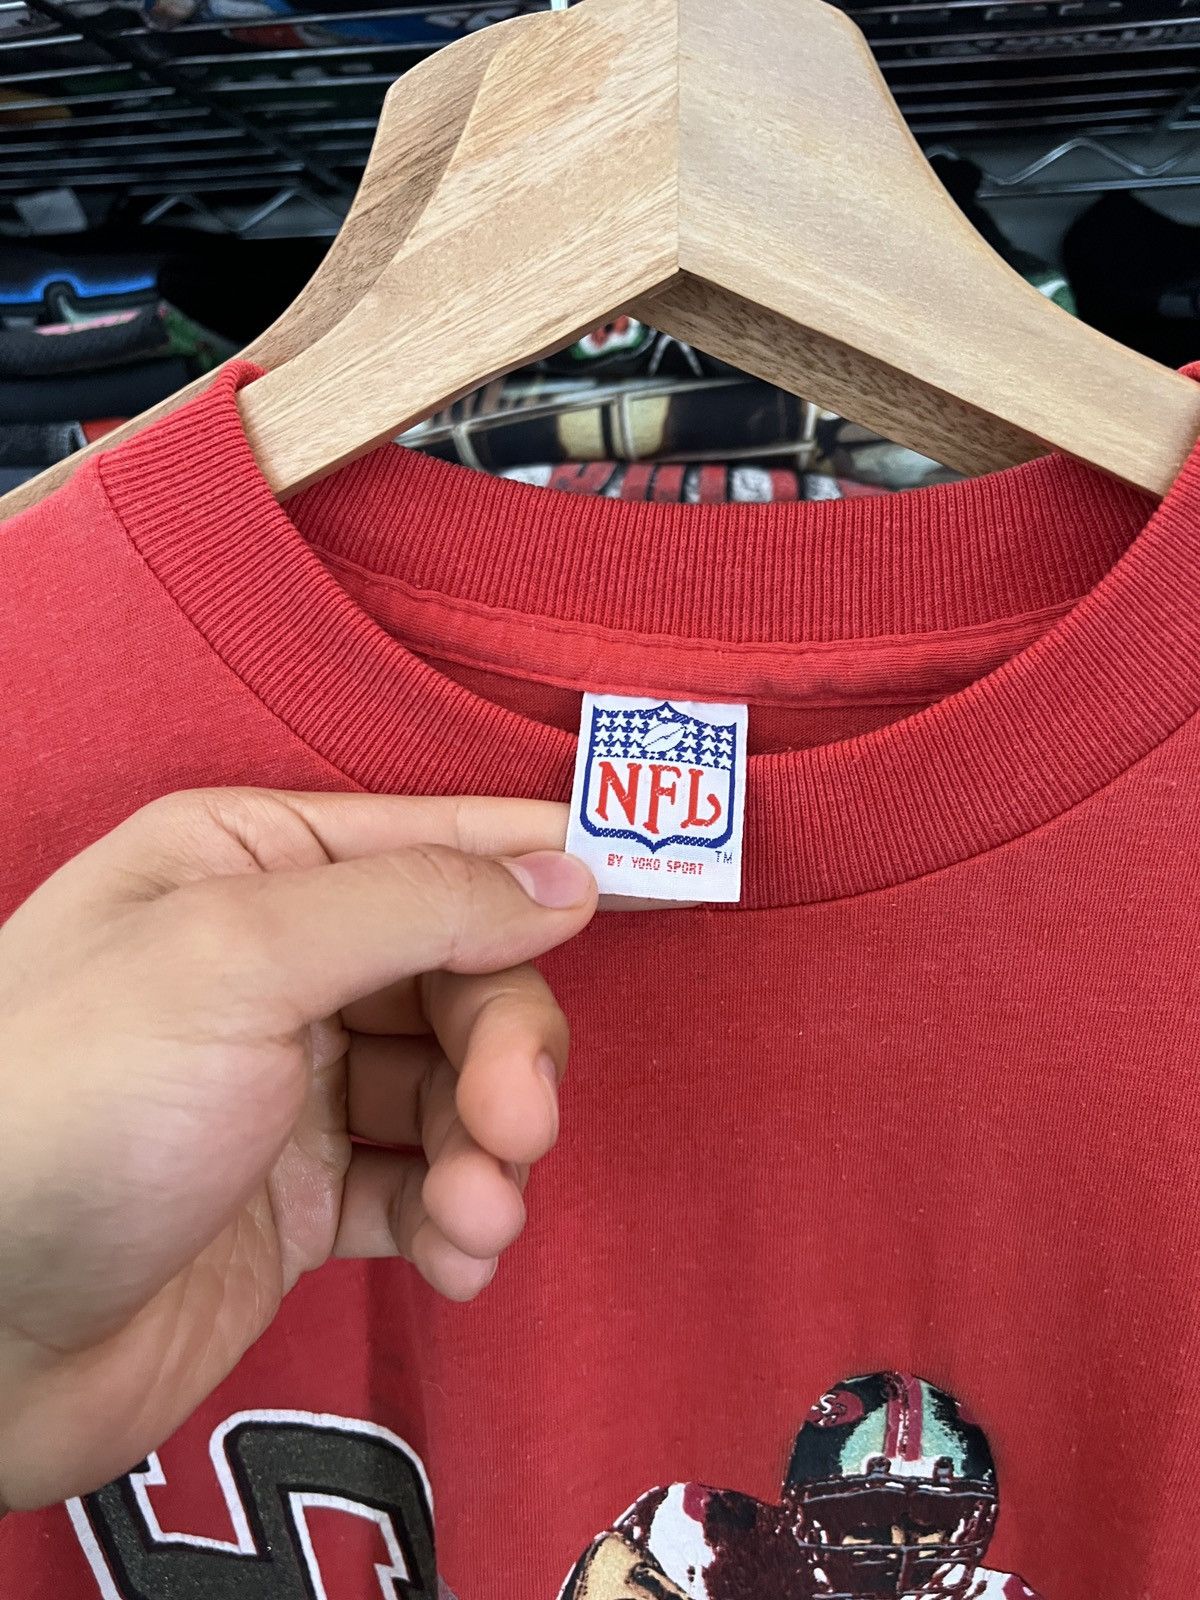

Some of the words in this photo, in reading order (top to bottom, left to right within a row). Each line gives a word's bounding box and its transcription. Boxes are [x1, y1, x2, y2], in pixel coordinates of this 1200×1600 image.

[594, 761, 722, 834] NFL
[607, 853, 623, 867] BY
[631, 856, 661, 871] YOKO
[666, 859, 704, 875] SPORT
[714, 850, 733, 864] TM
